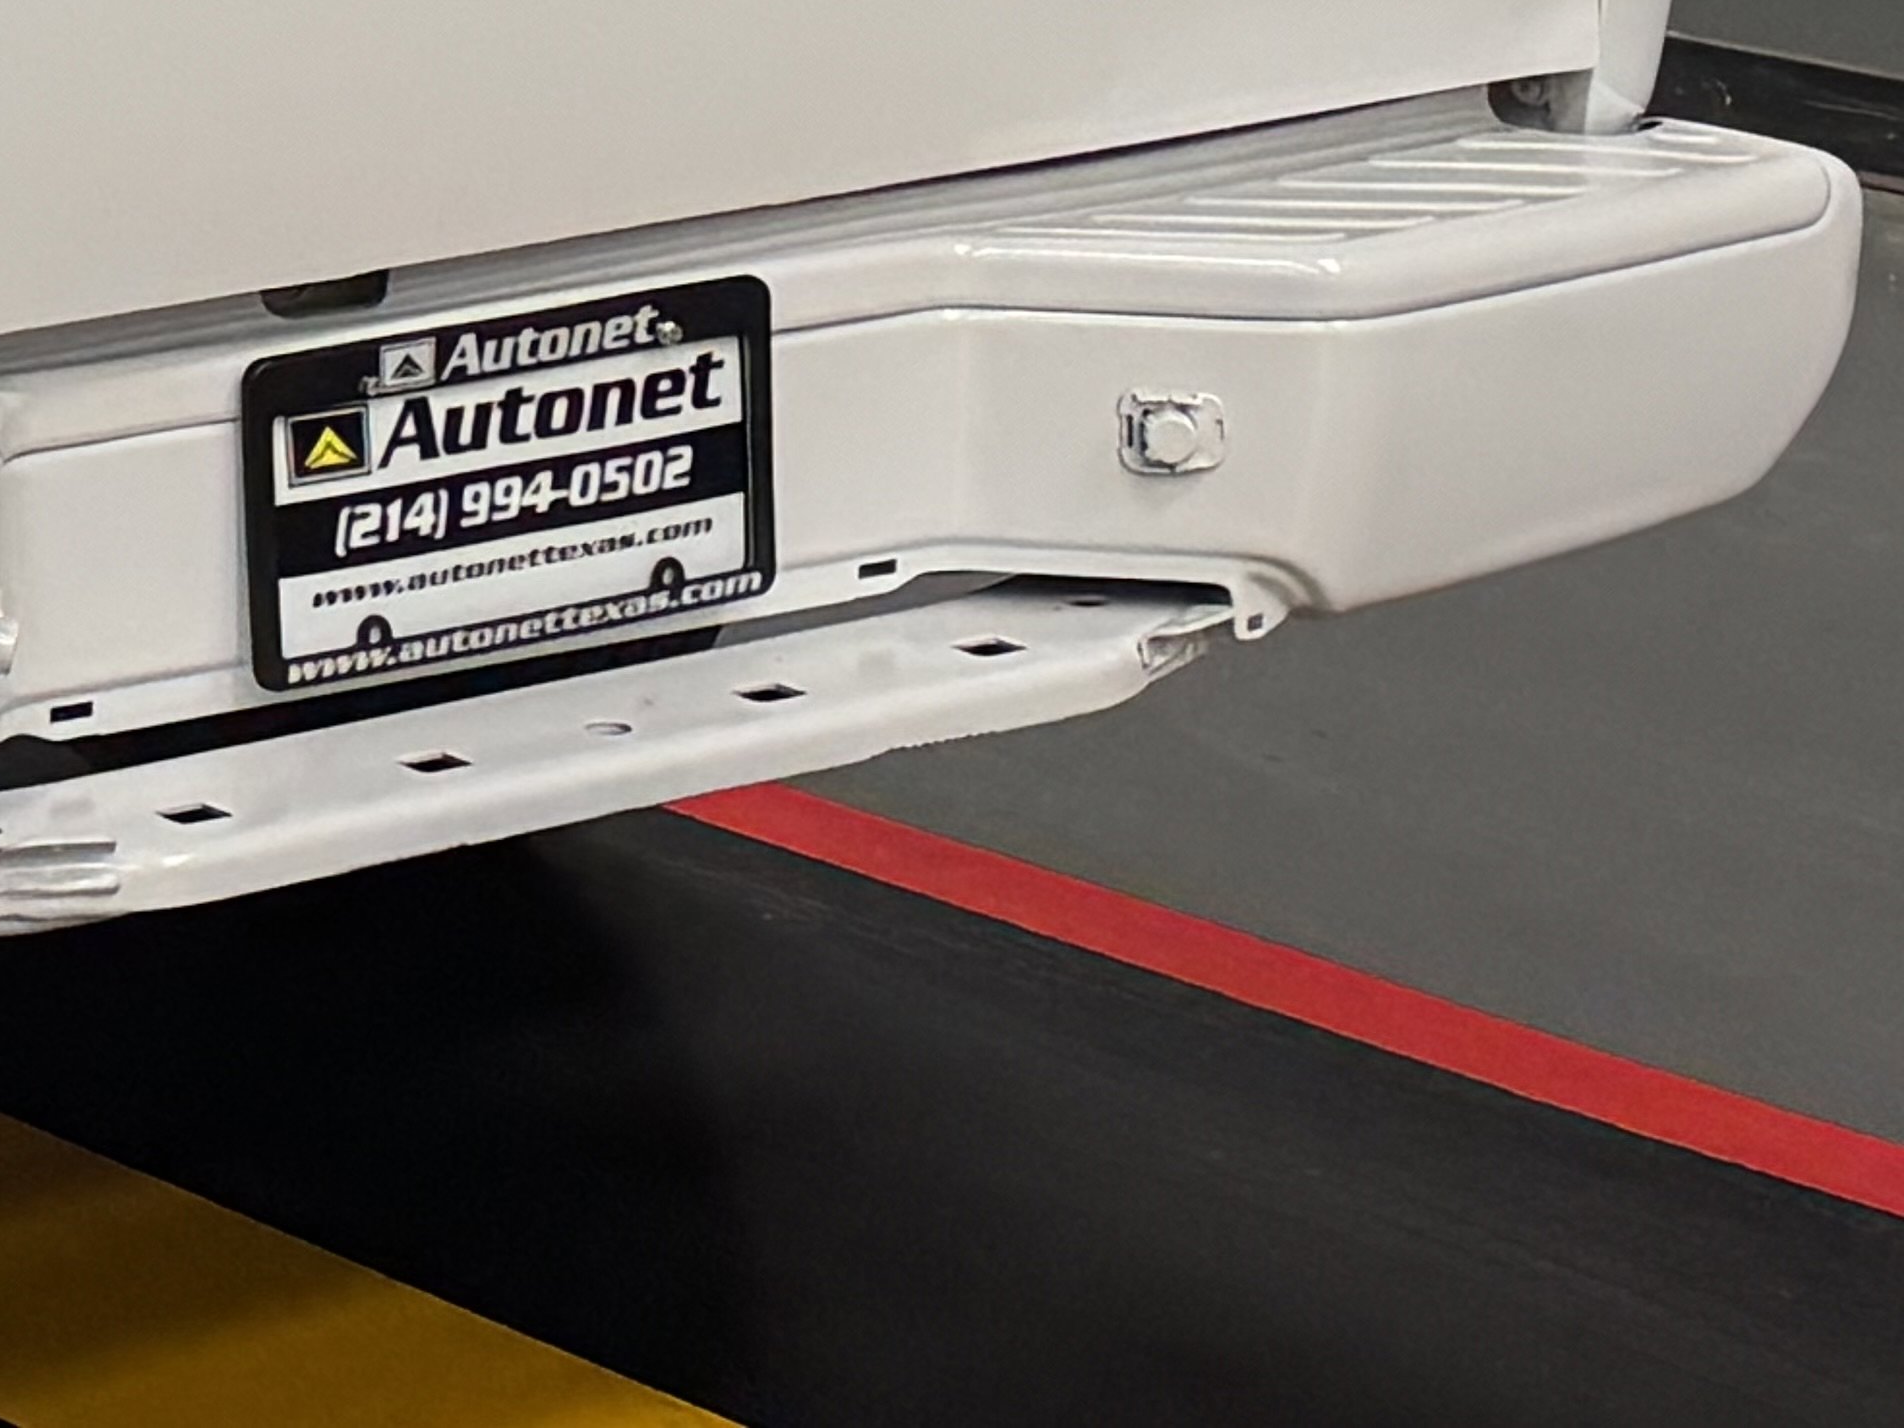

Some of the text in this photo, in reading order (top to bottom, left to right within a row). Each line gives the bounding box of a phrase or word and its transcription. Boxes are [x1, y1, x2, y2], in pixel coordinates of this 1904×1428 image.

[440, 304, 660, 381] Autonet
[377, 351, 725, 470] Autonet
[335, 444, 694, 558] (214) 994-0502
[312, 517, 714, 609] www.autonettexas.com
[287, 570, 763, 685] www.autonettexas.com
